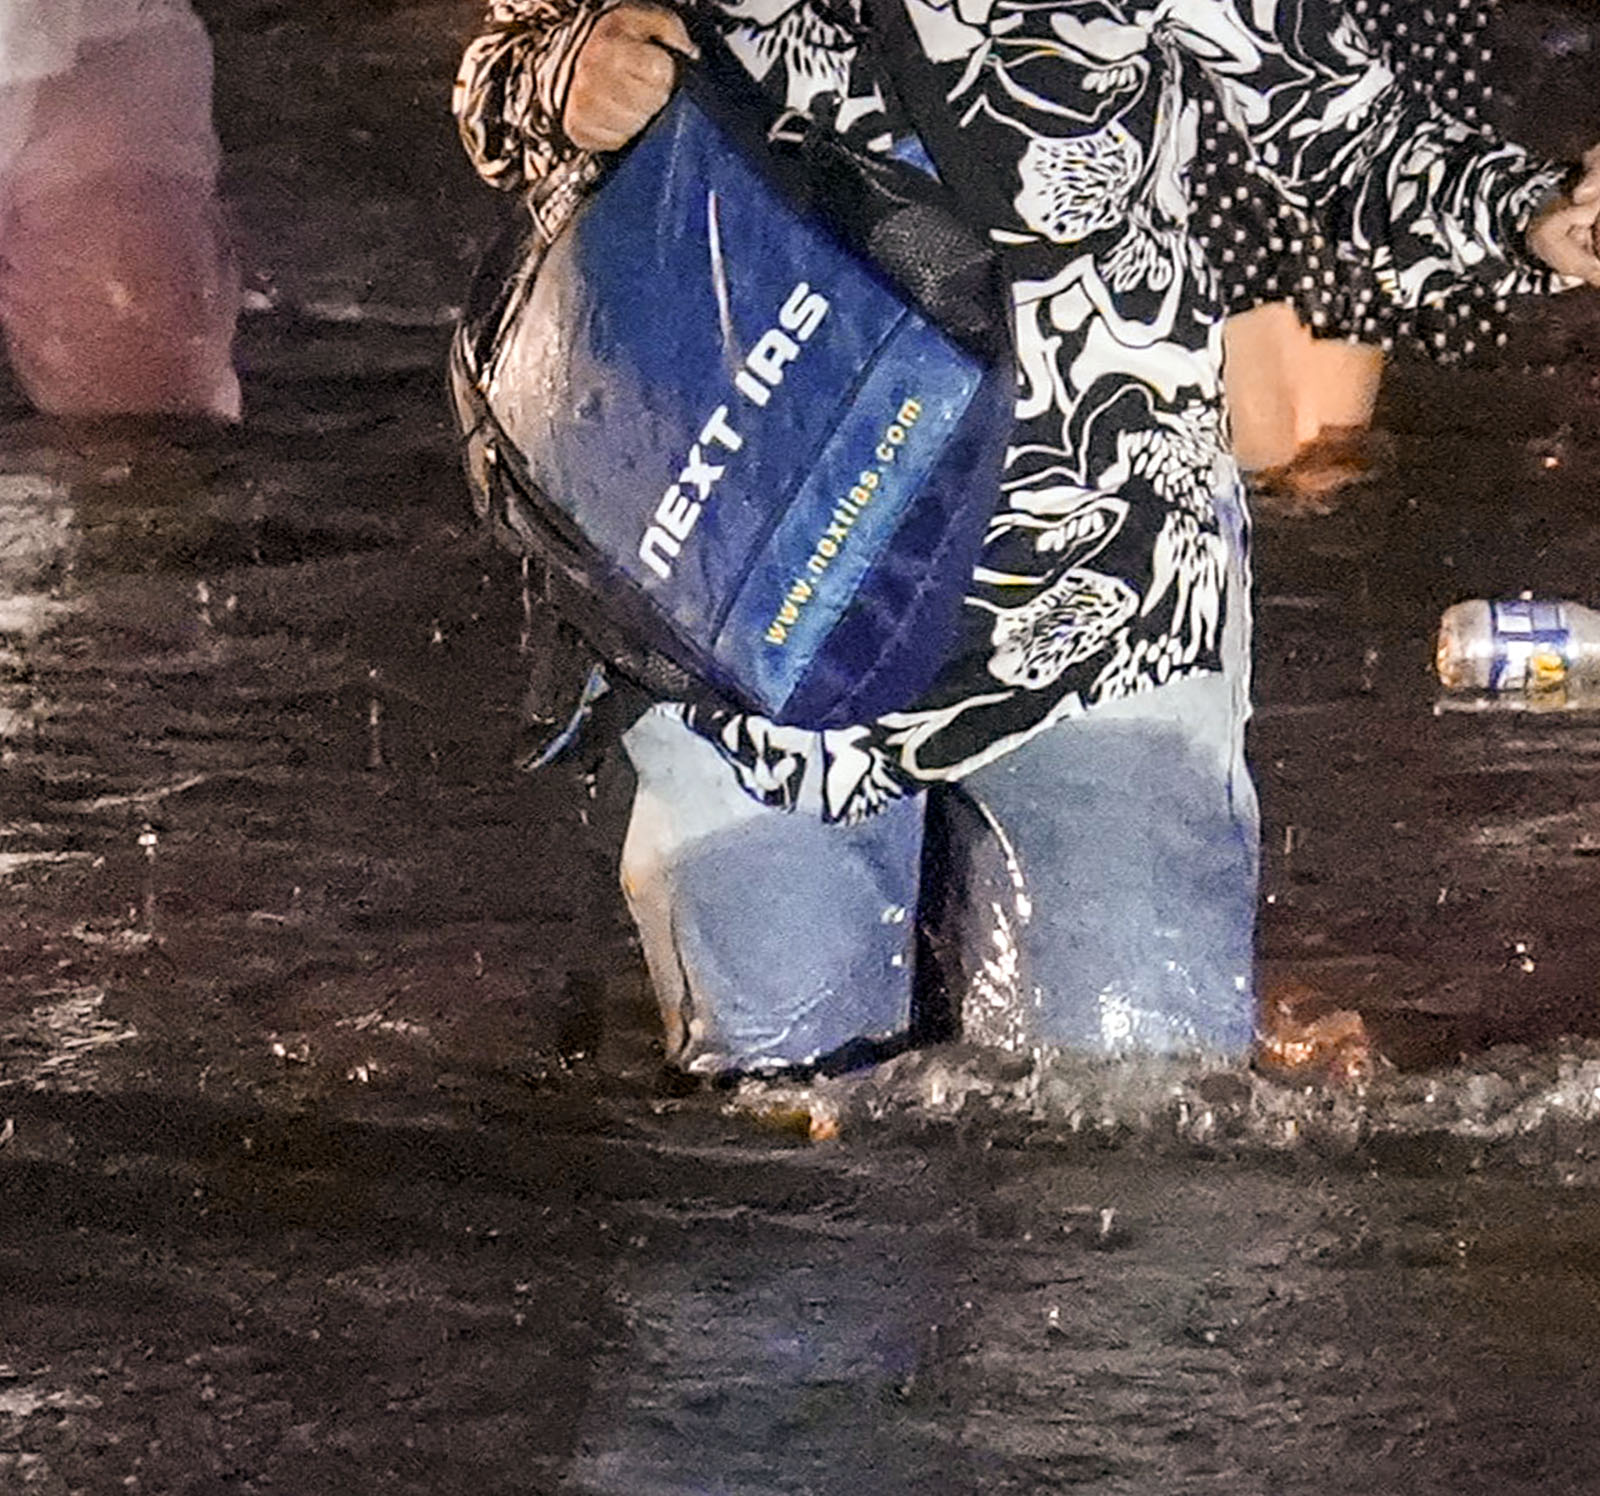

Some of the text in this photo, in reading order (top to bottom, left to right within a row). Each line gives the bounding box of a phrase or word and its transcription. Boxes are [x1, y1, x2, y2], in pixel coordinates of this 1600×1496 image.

[638, 281, 830, 580] NEXT IAS
[763, 397, 923, 646] www.nextias.com
